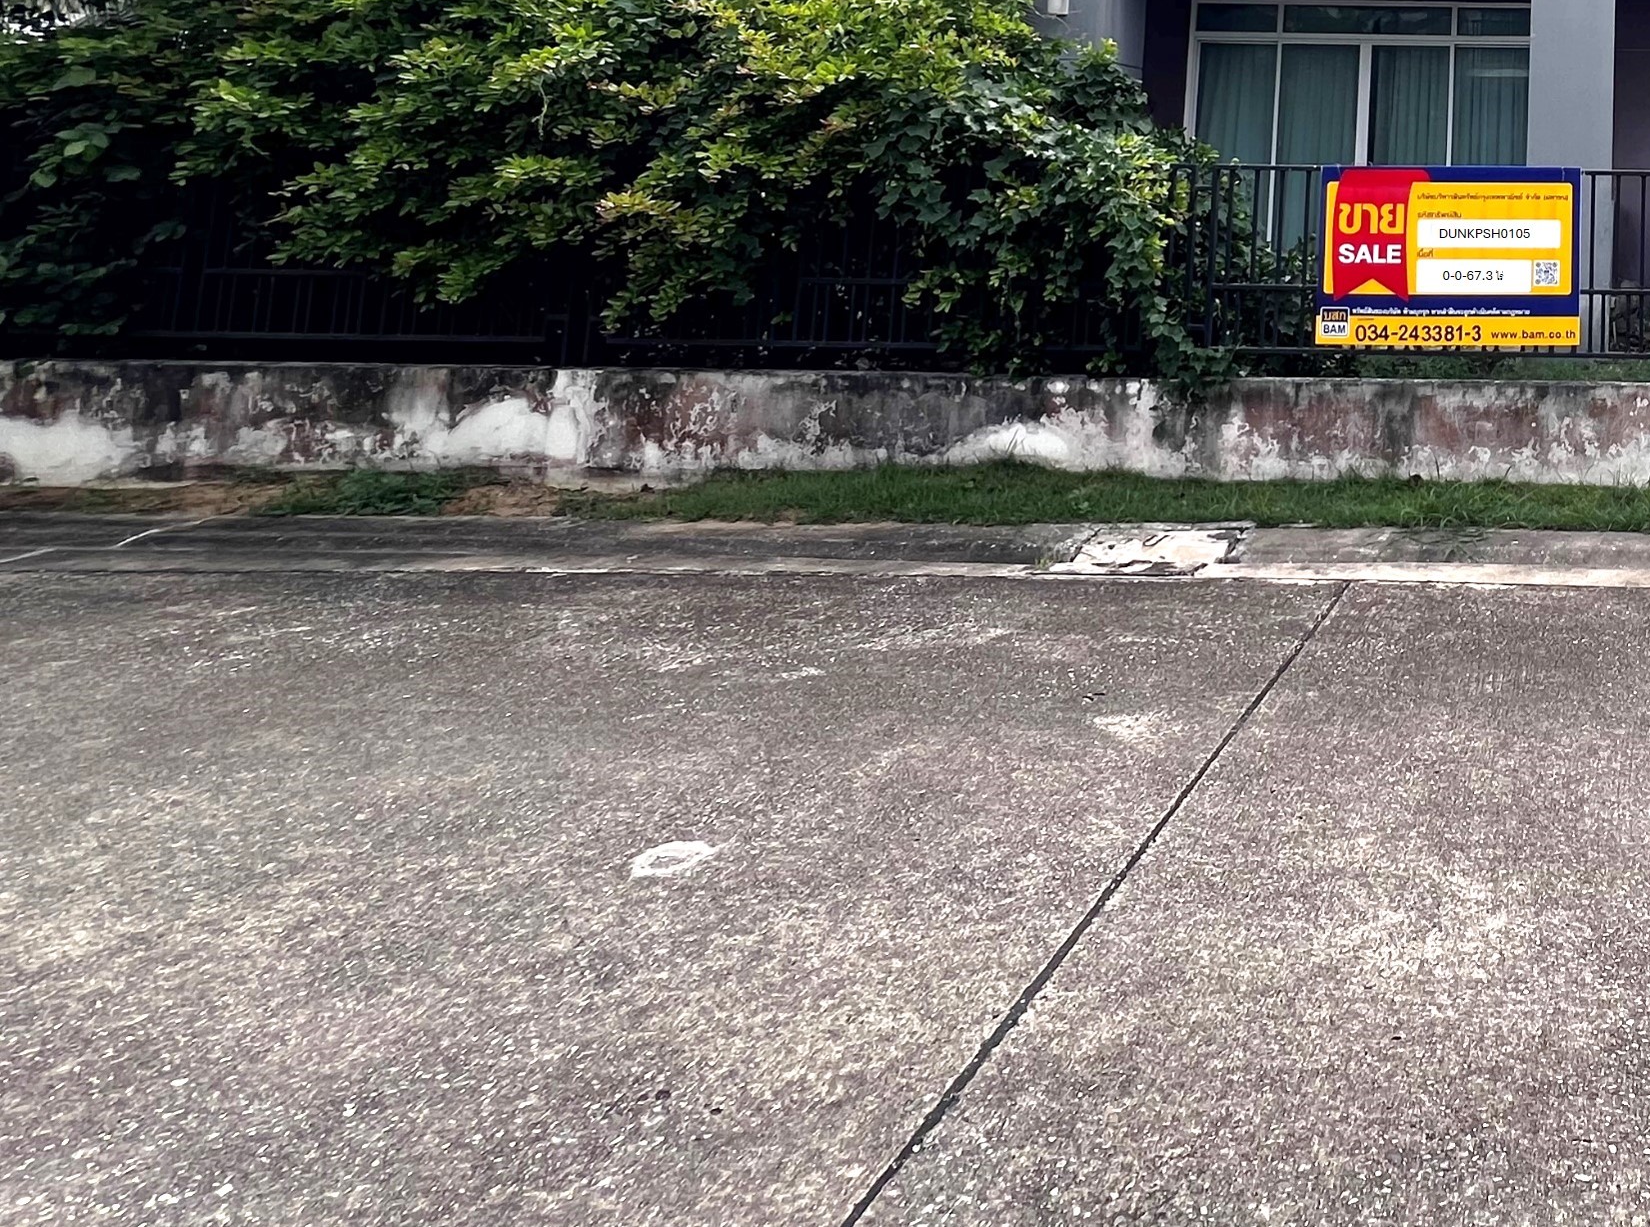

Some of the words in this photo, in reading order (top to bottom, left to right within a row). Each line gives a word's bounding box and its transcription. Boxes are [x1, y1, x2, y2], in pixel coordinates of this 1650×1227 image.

[1339, 203, 1405, 234] ขาย
[1439, 228, 1531, 239] DUNKPSH0105
[1338, 243, 1402, 264] SALE
[1442, 270, 1494, 281] 0-0-67.3
[1323, 310, 1347, 322] บสก
[1323, 323, 1346, 334] BAM
[1355, 324, 1482, 342] 034-243381-3
